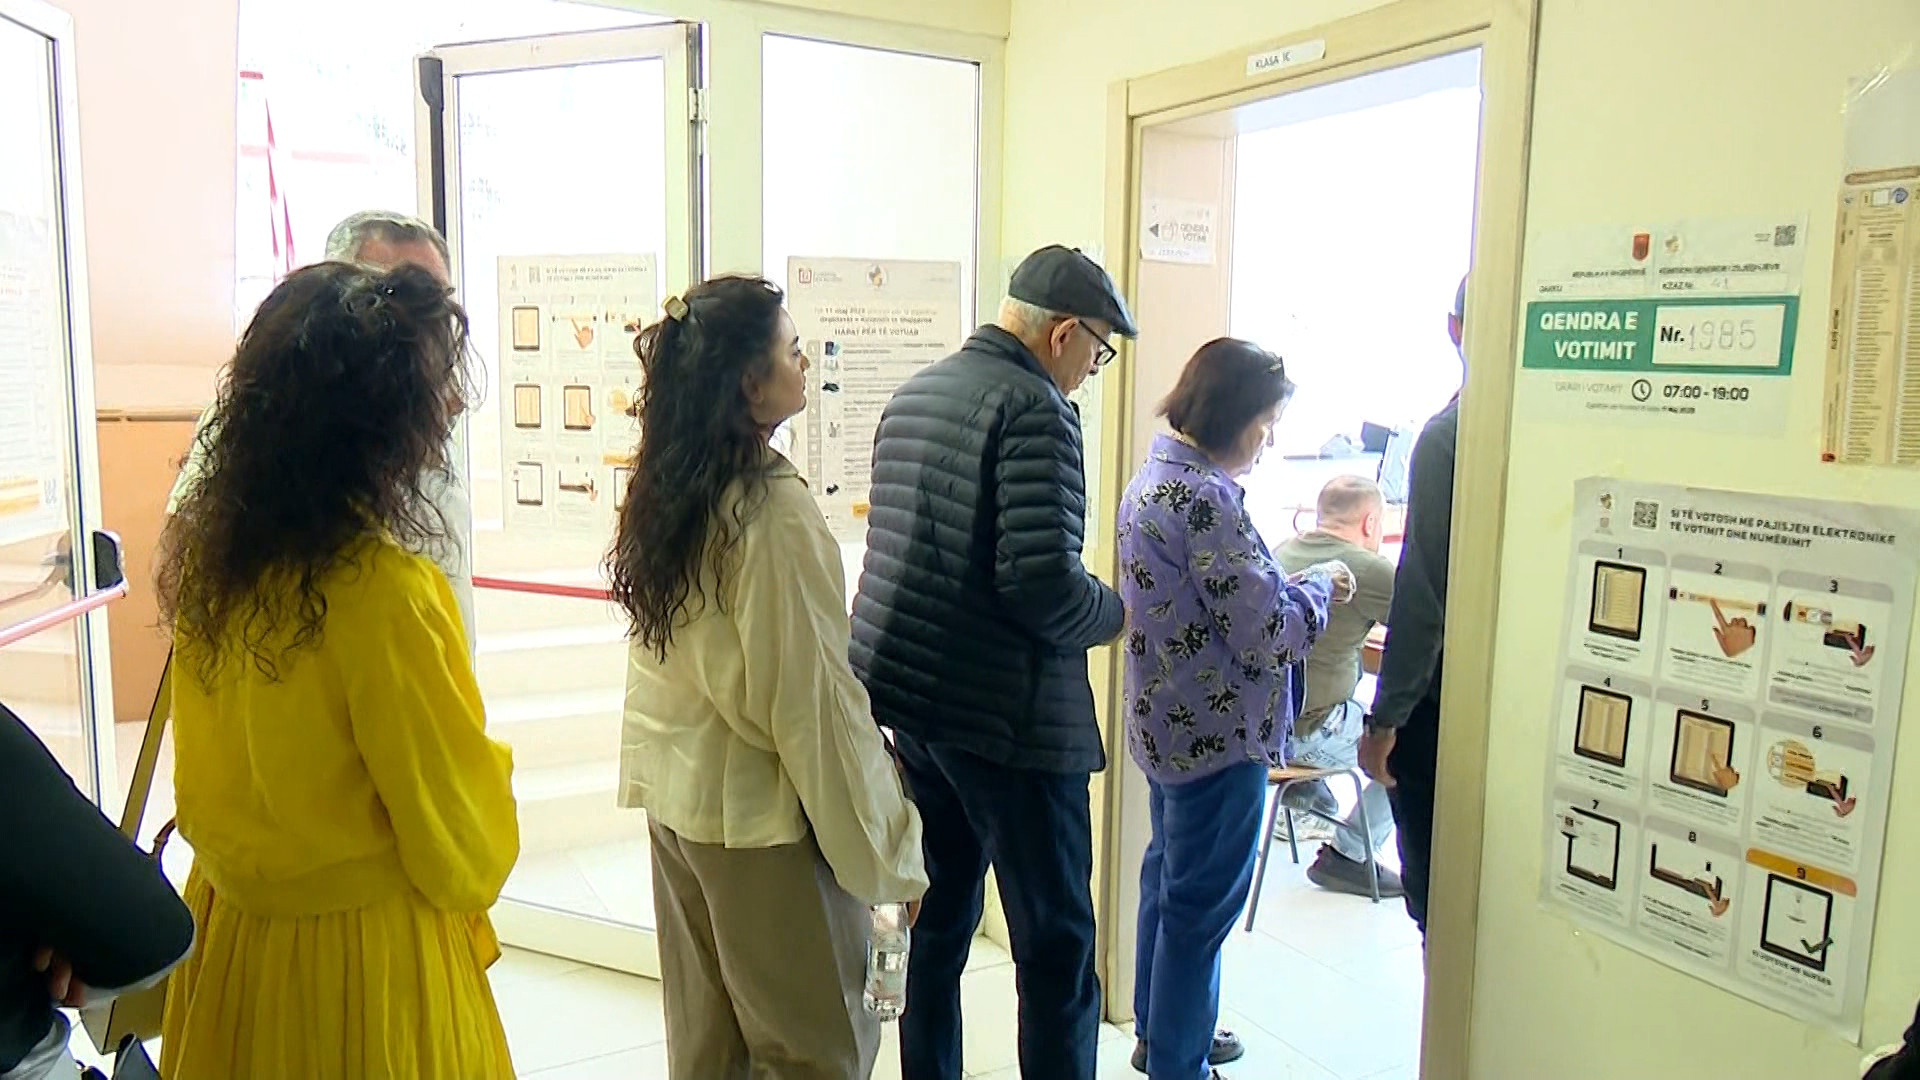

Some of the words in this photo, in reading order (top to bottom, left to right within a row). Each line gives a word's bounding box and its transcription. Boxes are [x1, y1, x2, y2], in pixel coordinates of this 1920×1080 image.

[1255, 55, 1280, 69] KLASA
[1540, 311, 1621, 331] QENDRA
[1624, 311, 1639, 330] E
[1660, 325, 1685, 342] Nr.
[1689, 320, 1757, 351] 1985
[1554, 340, 1638, 360] VOTIMIT
[1663, 385, 1702, 398] 07:00
[1712, 387, 1749, 401] 19:00
[1683, 523, 1725, 537] VOTIMIT
[1726, 529, 1748, 540] DHE
[1696, 511, 1738, 524] VOTOSH
[1756, 519, 1810, 534] PAJISJEN
[1812, 525, 1896, 545] ELEKTRONIKE
[1617, 547, 1623, 560] 1
[1713, 562, 1723, 575] 2
[1828, 579, 1839, 594] 3
[1603, 676, 1611, 688] 4
[1700, 698, 1709, 712] 5
[1811, 725, 1823, 739] 6
[1592, 799, 1599, 810] 7
[1688, 830, 1697, 843] 8
[1796, 866, 1806, 880] 9
